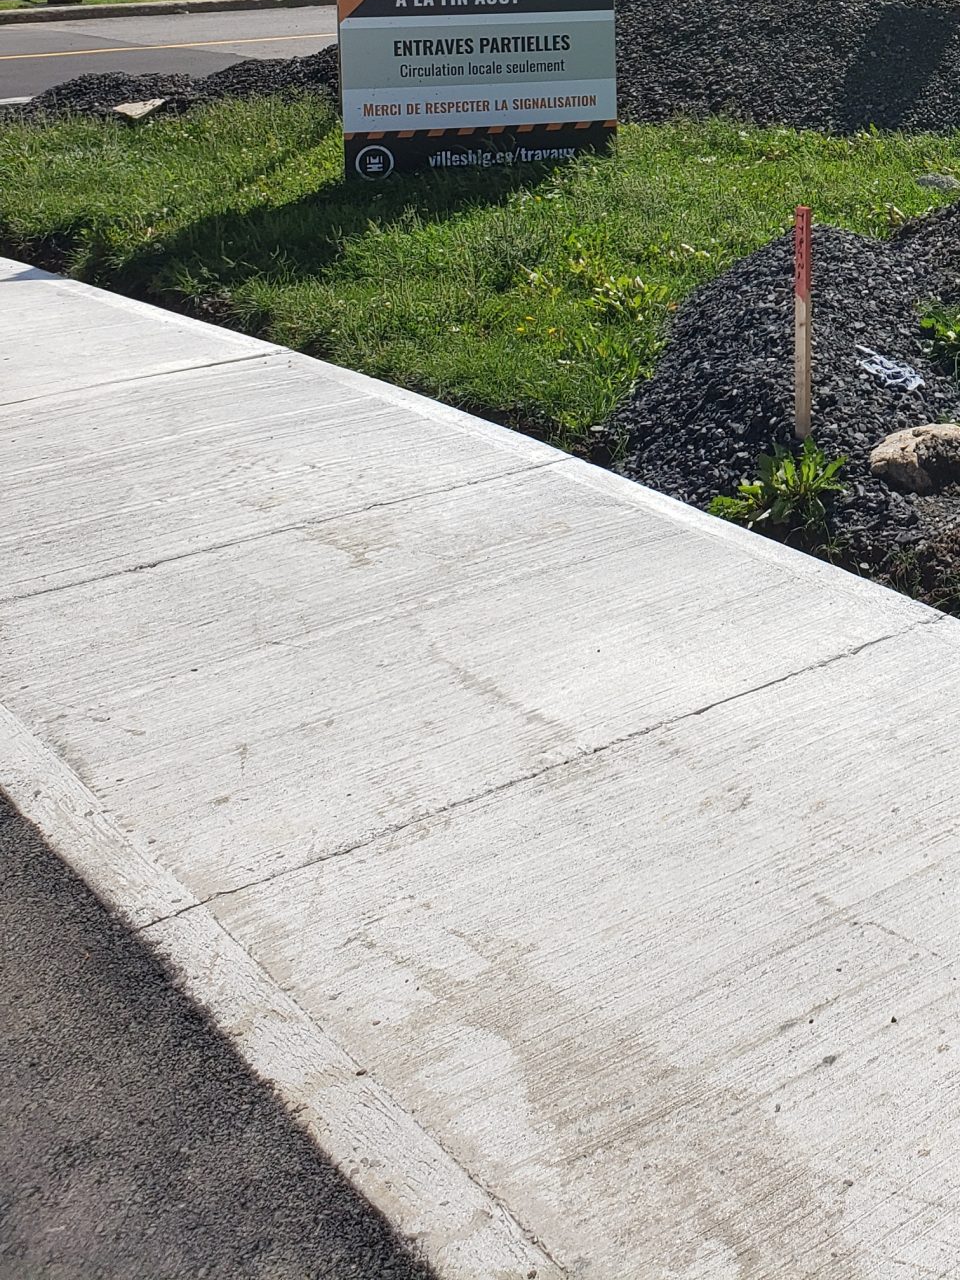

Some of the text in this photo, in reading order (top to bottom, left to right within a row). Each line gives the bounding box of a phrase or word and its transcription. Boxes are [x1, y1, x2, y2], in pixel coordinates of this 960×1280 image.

[394, 35, 570, 56] ENTRAVES PARTIELLES
[400, 60, 565, 78] Circulation locale seulement
[363, 95, 597, 117] MERCI DE RESPECTER LA SIGNALISATION
